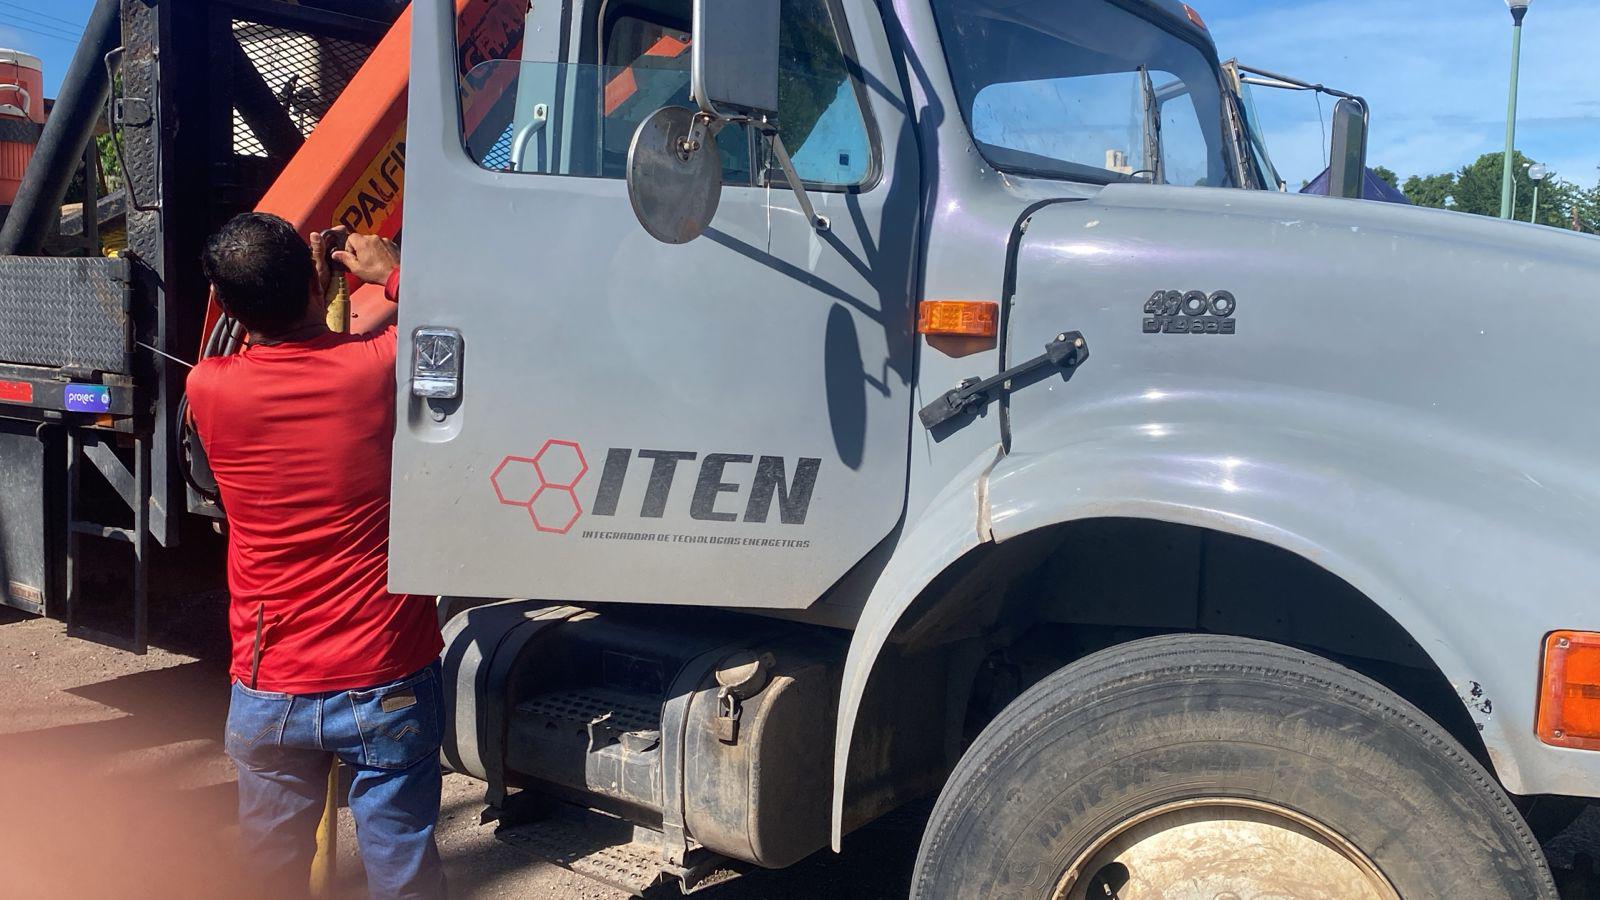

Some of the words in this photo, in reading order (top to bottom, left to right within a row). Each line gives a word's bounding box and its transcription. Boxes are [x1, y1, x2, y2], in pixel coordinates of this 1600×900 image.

[1143, 289, 1236, 318] 4900
[591, 447, 822, 525] ITEN
[581, 530, 656, 541] INTEGRADORA
[656, 533, 671, 543] DE
[672, 534, 741, 546] TECNOLOGIAS
[742, 537, 811, 549] ENERGETICAS
